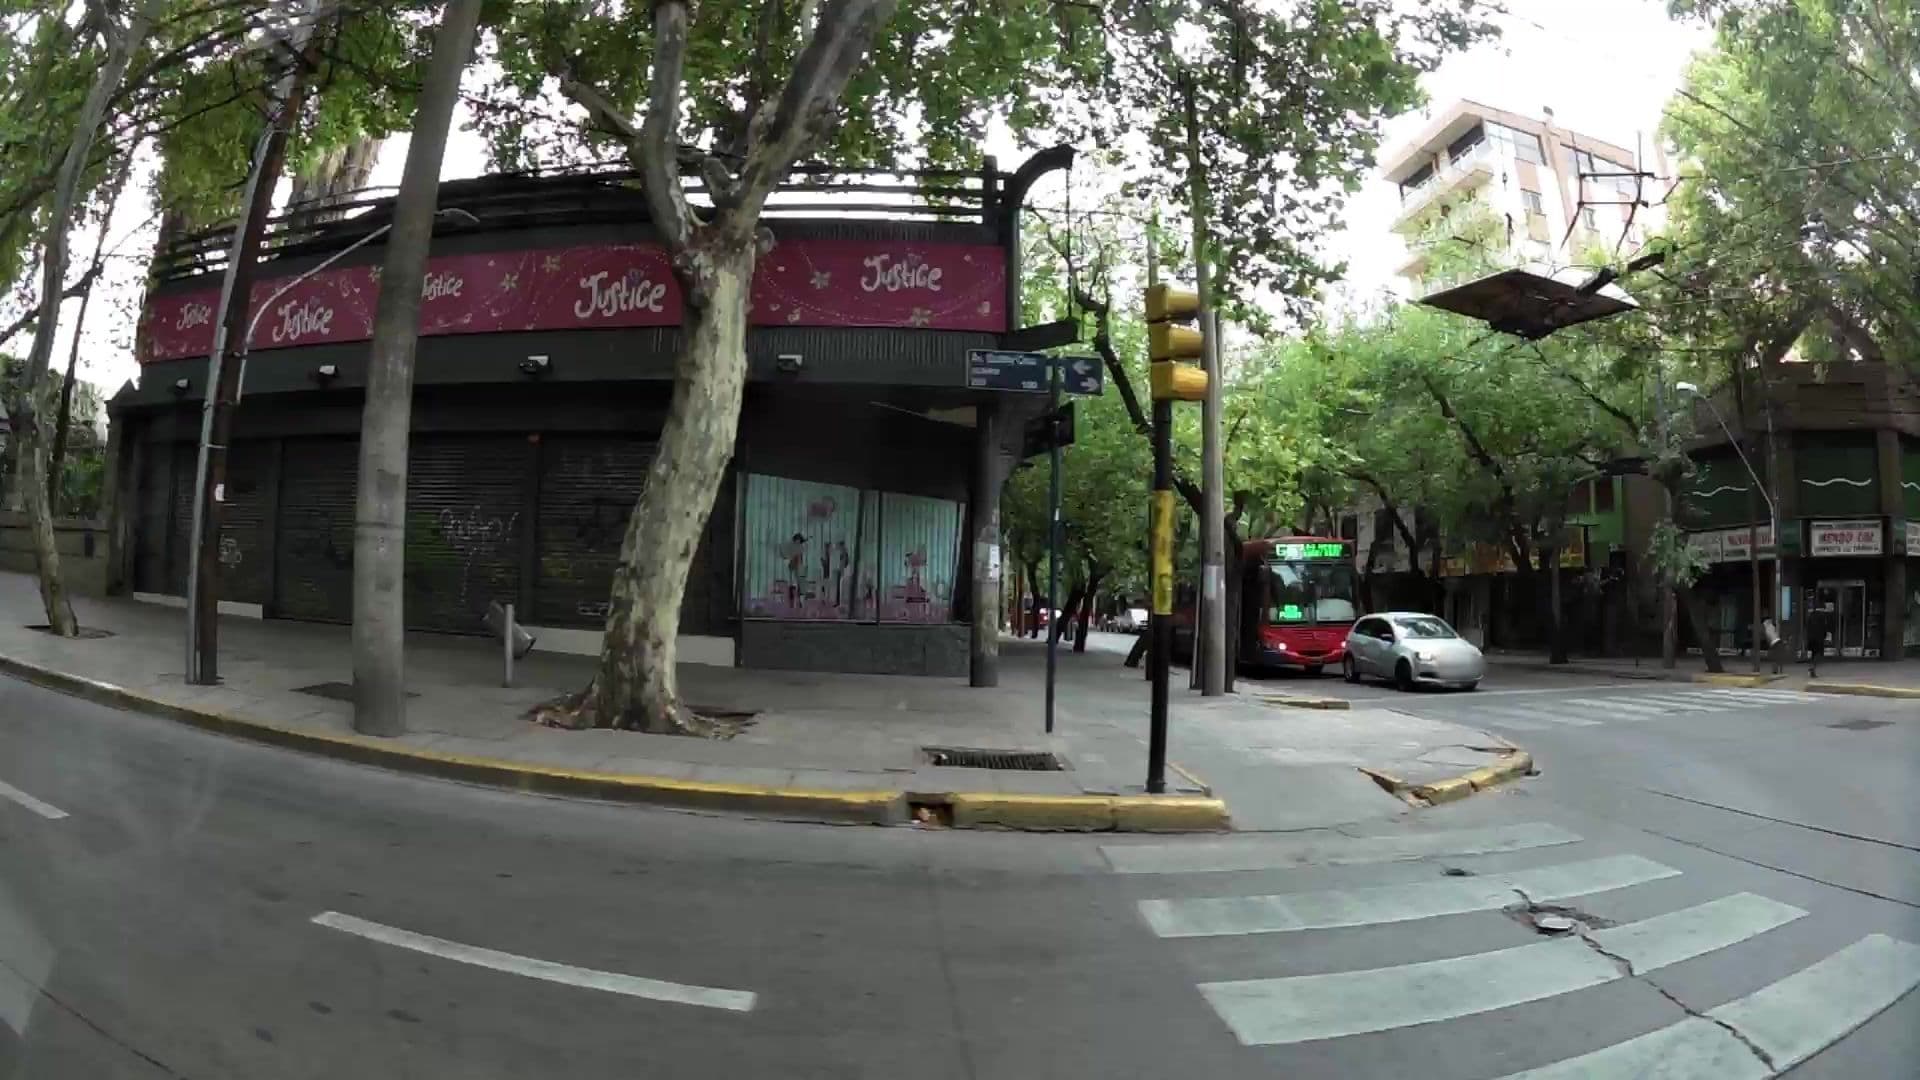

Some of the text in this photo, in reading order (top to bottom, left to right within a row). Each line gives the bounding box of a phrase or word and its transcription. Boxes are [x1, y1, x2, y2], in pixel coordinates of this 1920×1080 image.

[861, 255, 943, 292] Justice
[574, 271, 666, 318] Justice
[176, 302, 212, 330] Justice
[271, 301, 334, 342] Justice
